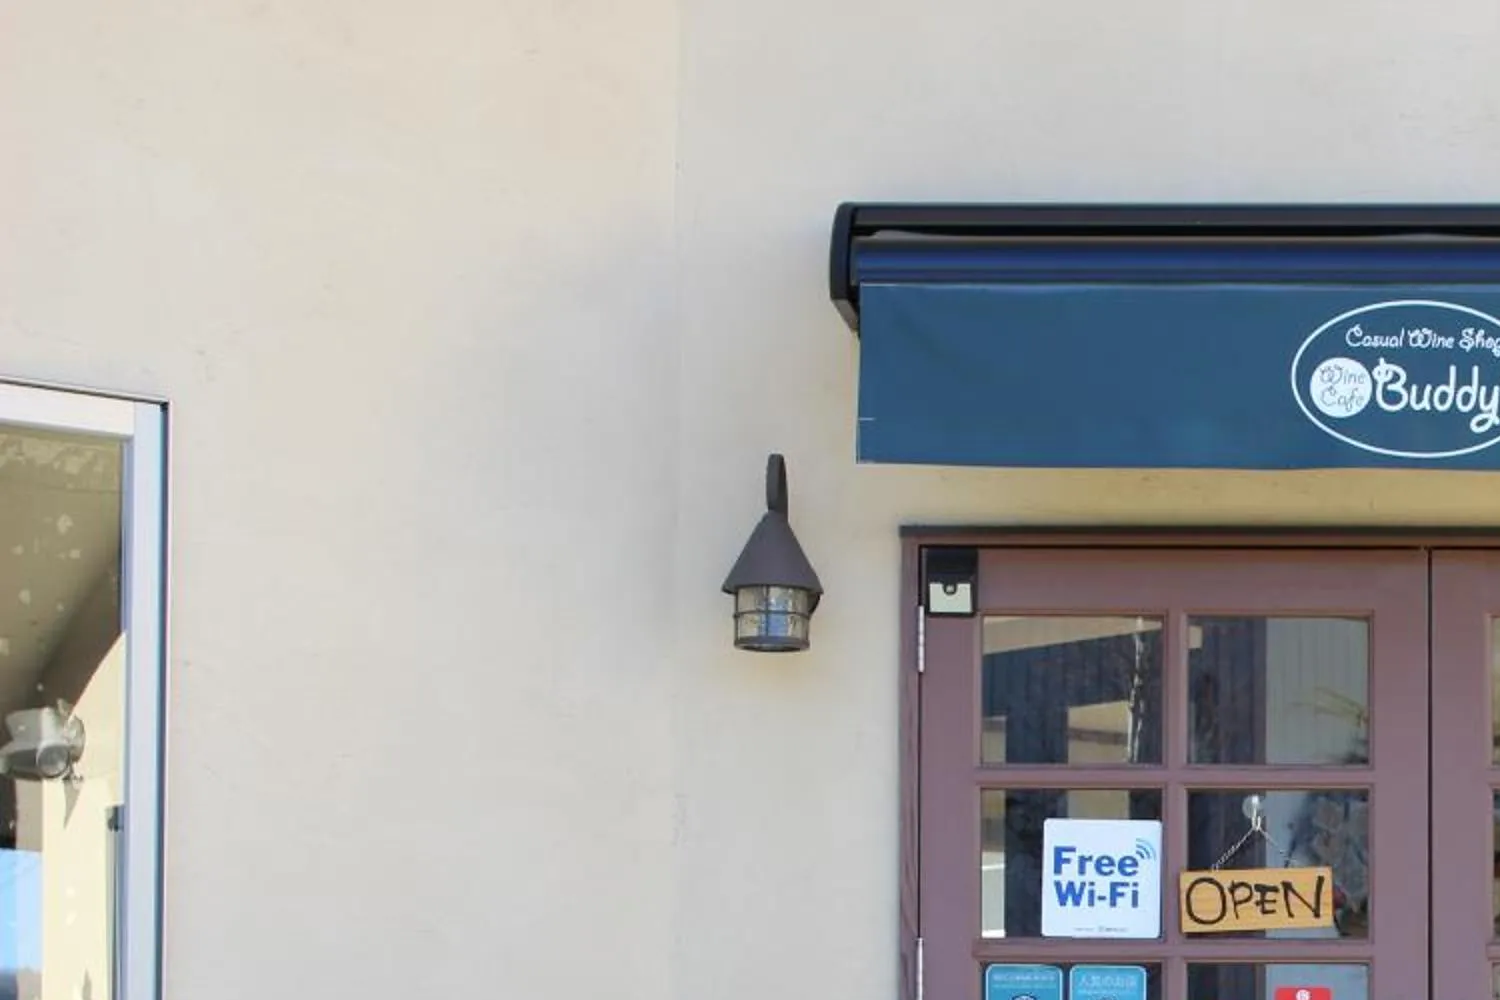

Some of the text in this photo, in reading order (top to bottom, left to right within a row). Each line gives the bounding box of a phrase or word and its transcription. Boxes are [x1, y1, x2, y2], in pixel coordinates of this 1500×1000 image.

[1345, 322, 1404, 349] Casual
[1409, 327, 1454, 349] Wine
[1319, 363, 1366, 385] Wine
[1053, 846, 1139, 877] Free
[1054, 880, 1140, 909] Wi-Fi
[1185, 875, 1326, 926] OPEN
